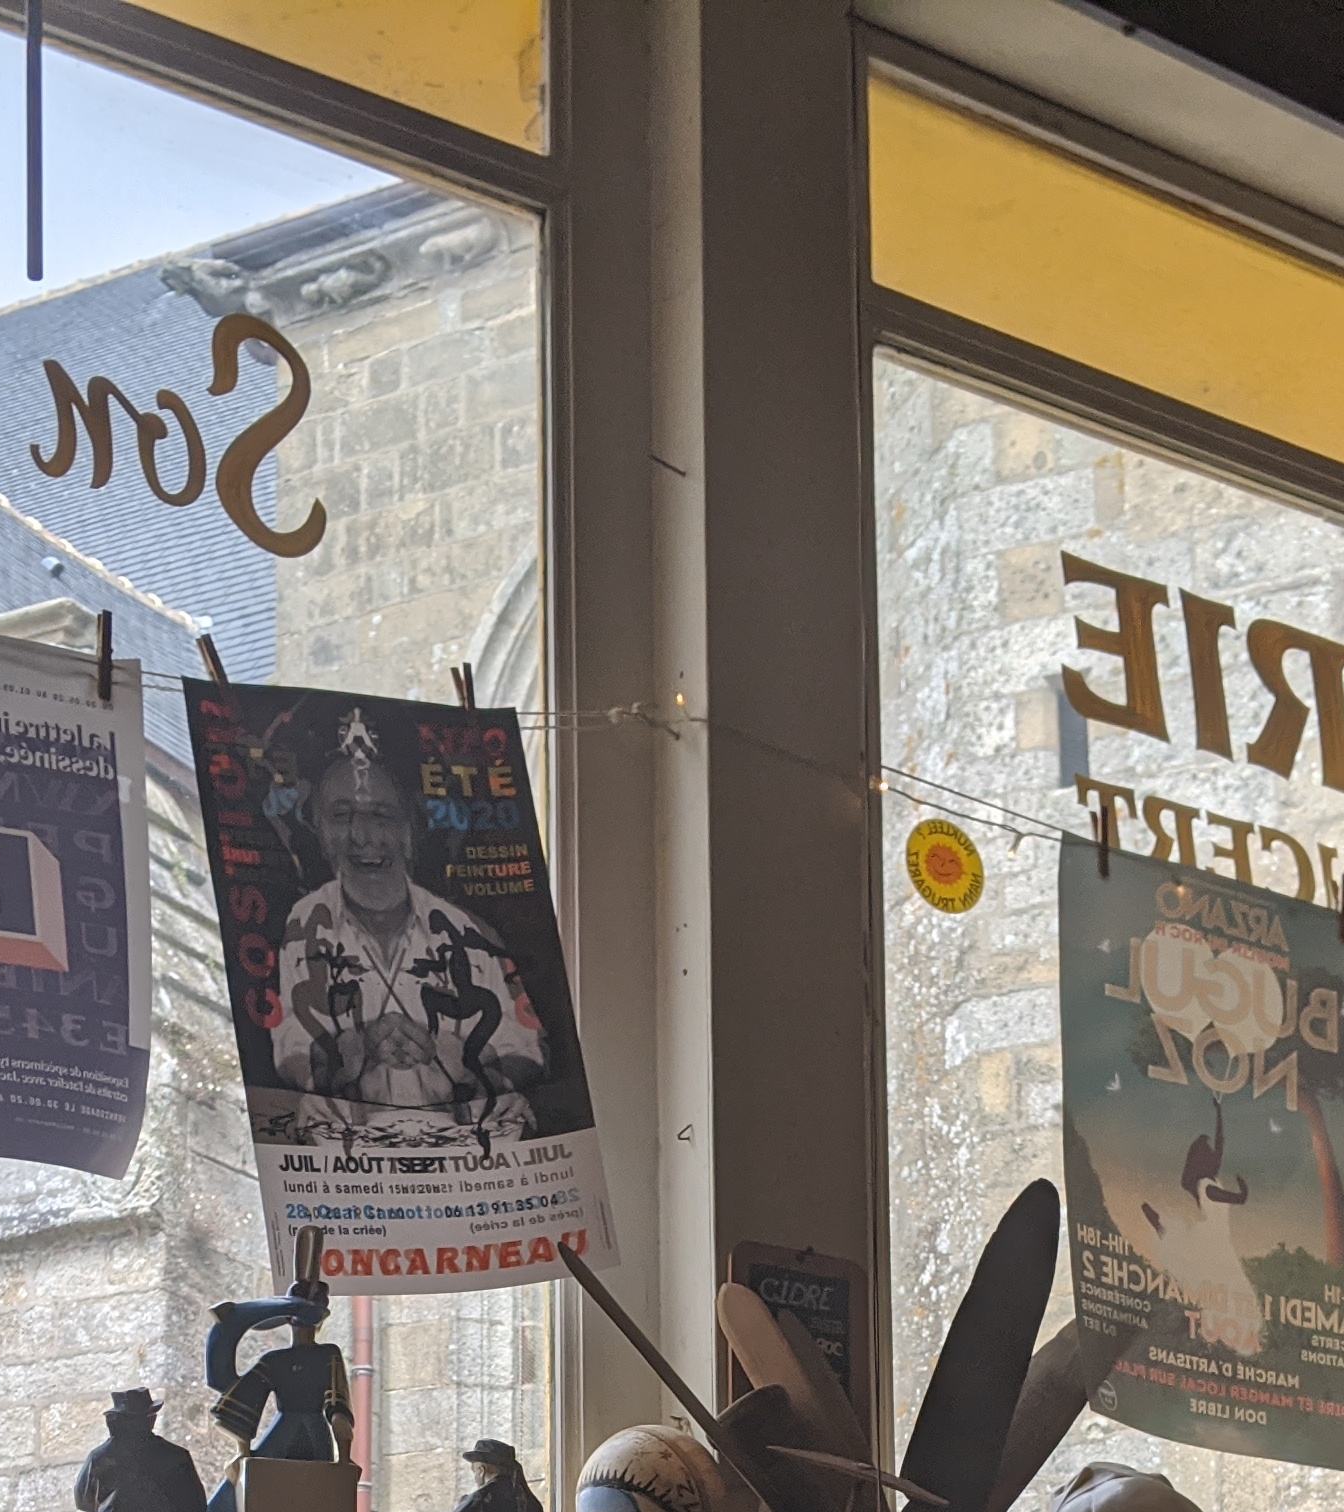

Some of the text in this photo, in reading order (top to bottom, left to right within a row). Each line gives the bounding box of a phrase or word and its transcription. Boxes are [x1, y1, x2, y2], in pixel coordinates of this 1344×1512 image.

[419, 755, 519, 799] ÉTÉ
[424, 798, 523, 832] 2020
[465, 842, 529, 860] DESSIN
[445, 859, 533, 879] PEINTURE
[462, 877, 536, 897] VOLUME
[279, 1154, 322, 1174] JUIL
[333, 1151, 385, 1175] AOÛT
[283, 1180, 319, 1196] lundi
[335, 1181, 385, 1195] samedi
[338, 1224, 351, 1237] la
[352, 1223, 388, 1238] criée)
[320, 1228, 588, 1278] ONCARNEAU
[758, 1276, 836, 1312] CIDRE
